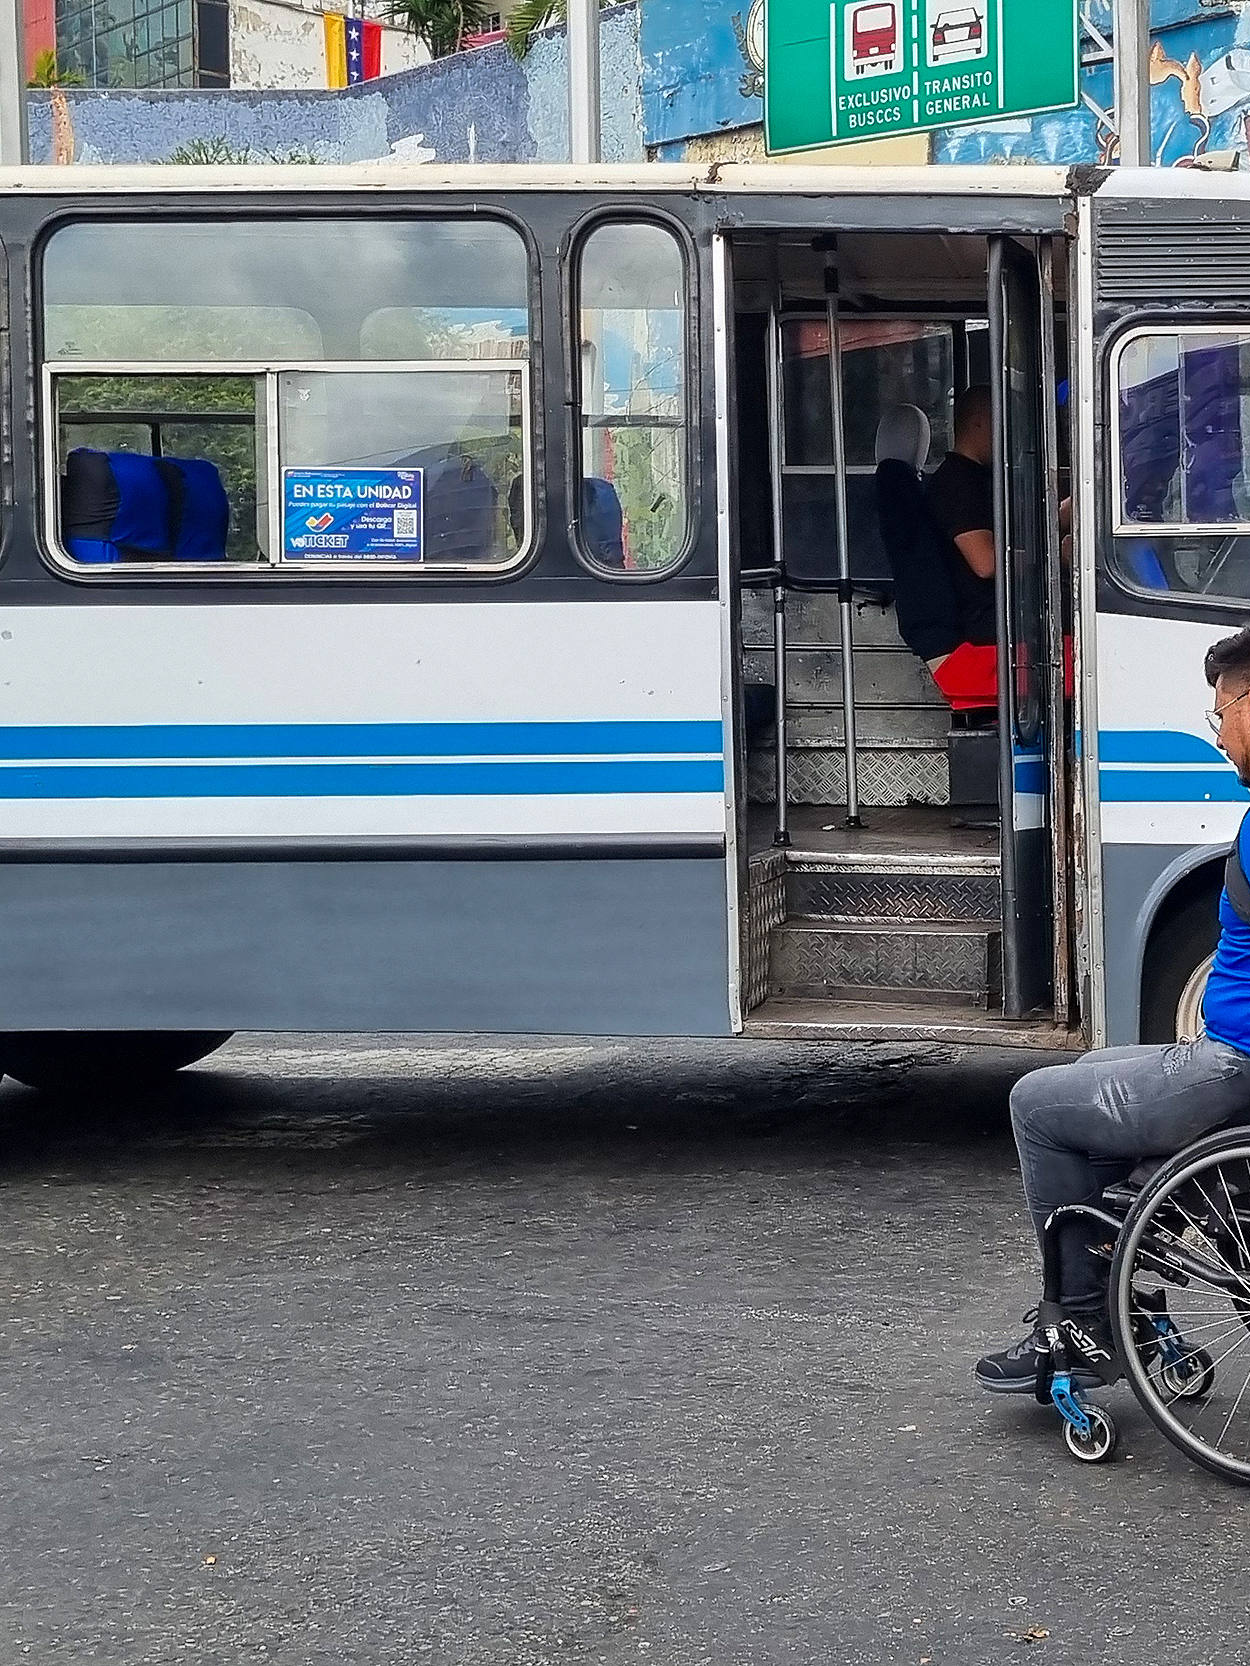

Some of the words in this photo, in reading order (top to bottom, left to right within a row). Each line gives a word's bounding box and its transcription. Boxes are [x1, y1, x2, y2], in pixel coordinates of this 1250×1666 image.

[924, 70, 993, 96] TRANSITO
[838, 85, 911, 111] EXCLUSIVO
[925, 92, 991, 115] GENERAL
[848, 106, 901, 129] BUSCCS
[293, 484, 314, 498] EN
[317, 484, 353, 498] ESTA
[357, 485, 412, 499] UNIDAD
[361, 515, 392, 524] Descarga
